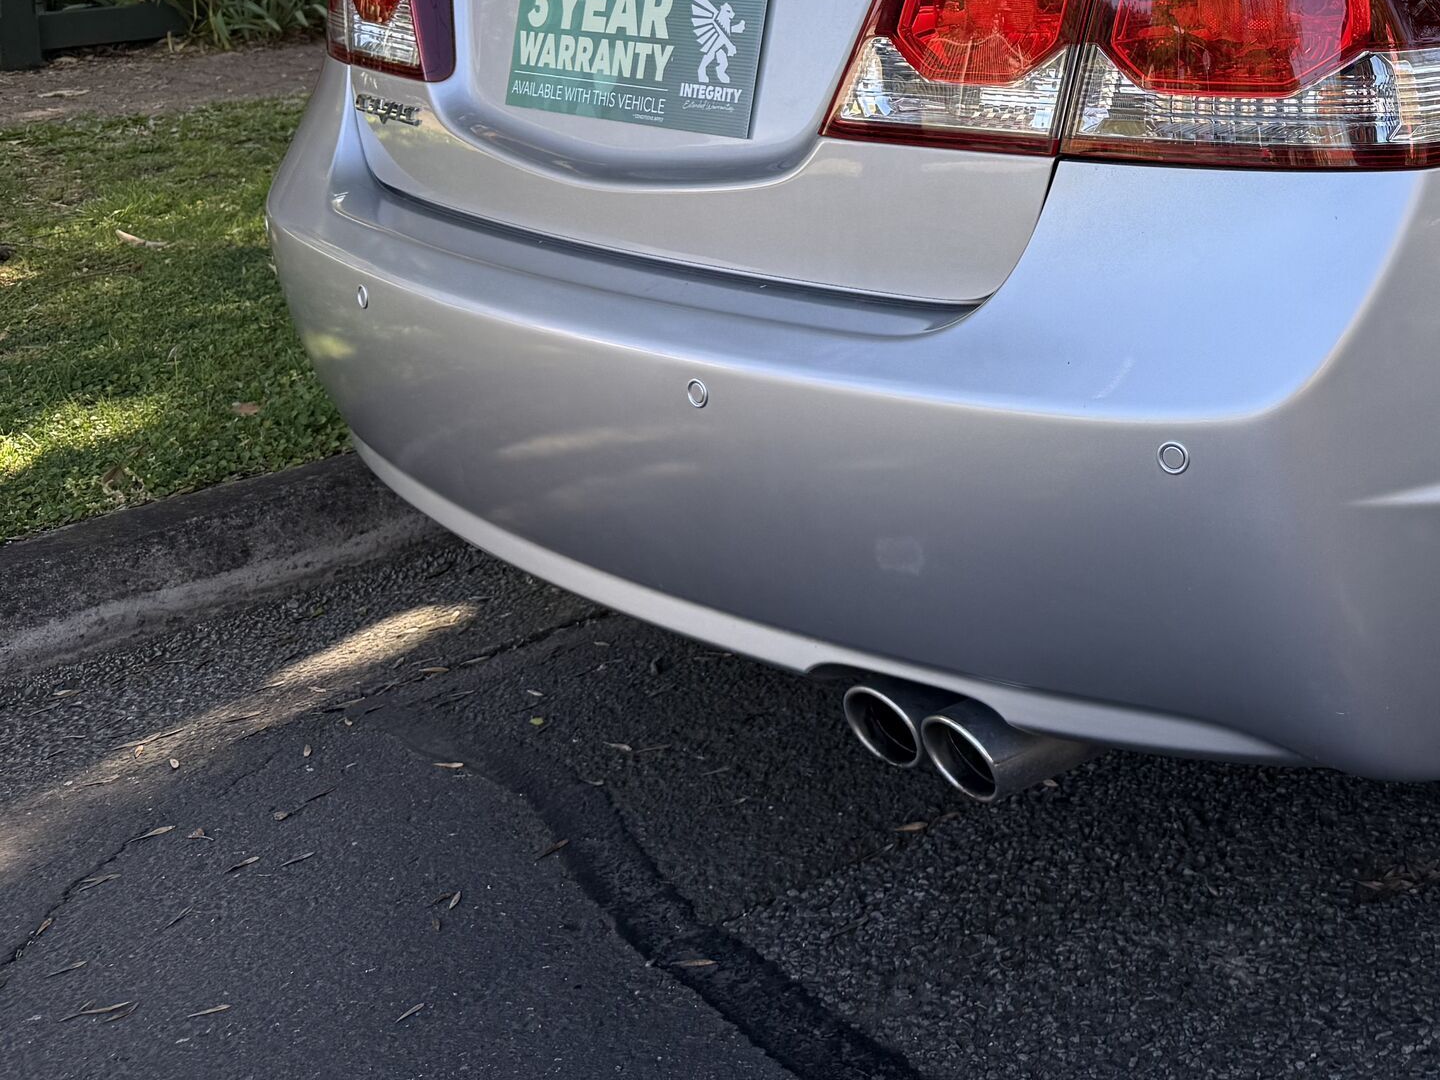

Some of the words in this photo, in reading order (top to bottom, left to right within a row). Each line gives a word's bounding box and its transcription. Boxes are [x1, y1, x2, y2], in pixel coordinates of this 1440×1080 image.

[519, 30, 675, 82] WARRANTY
[511, 79, 562, 102] AVAILABLE
[565, 87, 590, 105] WITH
[592, 91, 616, 108] THIS
[618, 94, 666, 114] VEHICLE
[679, 83, 742, 104] INTEGRITY
